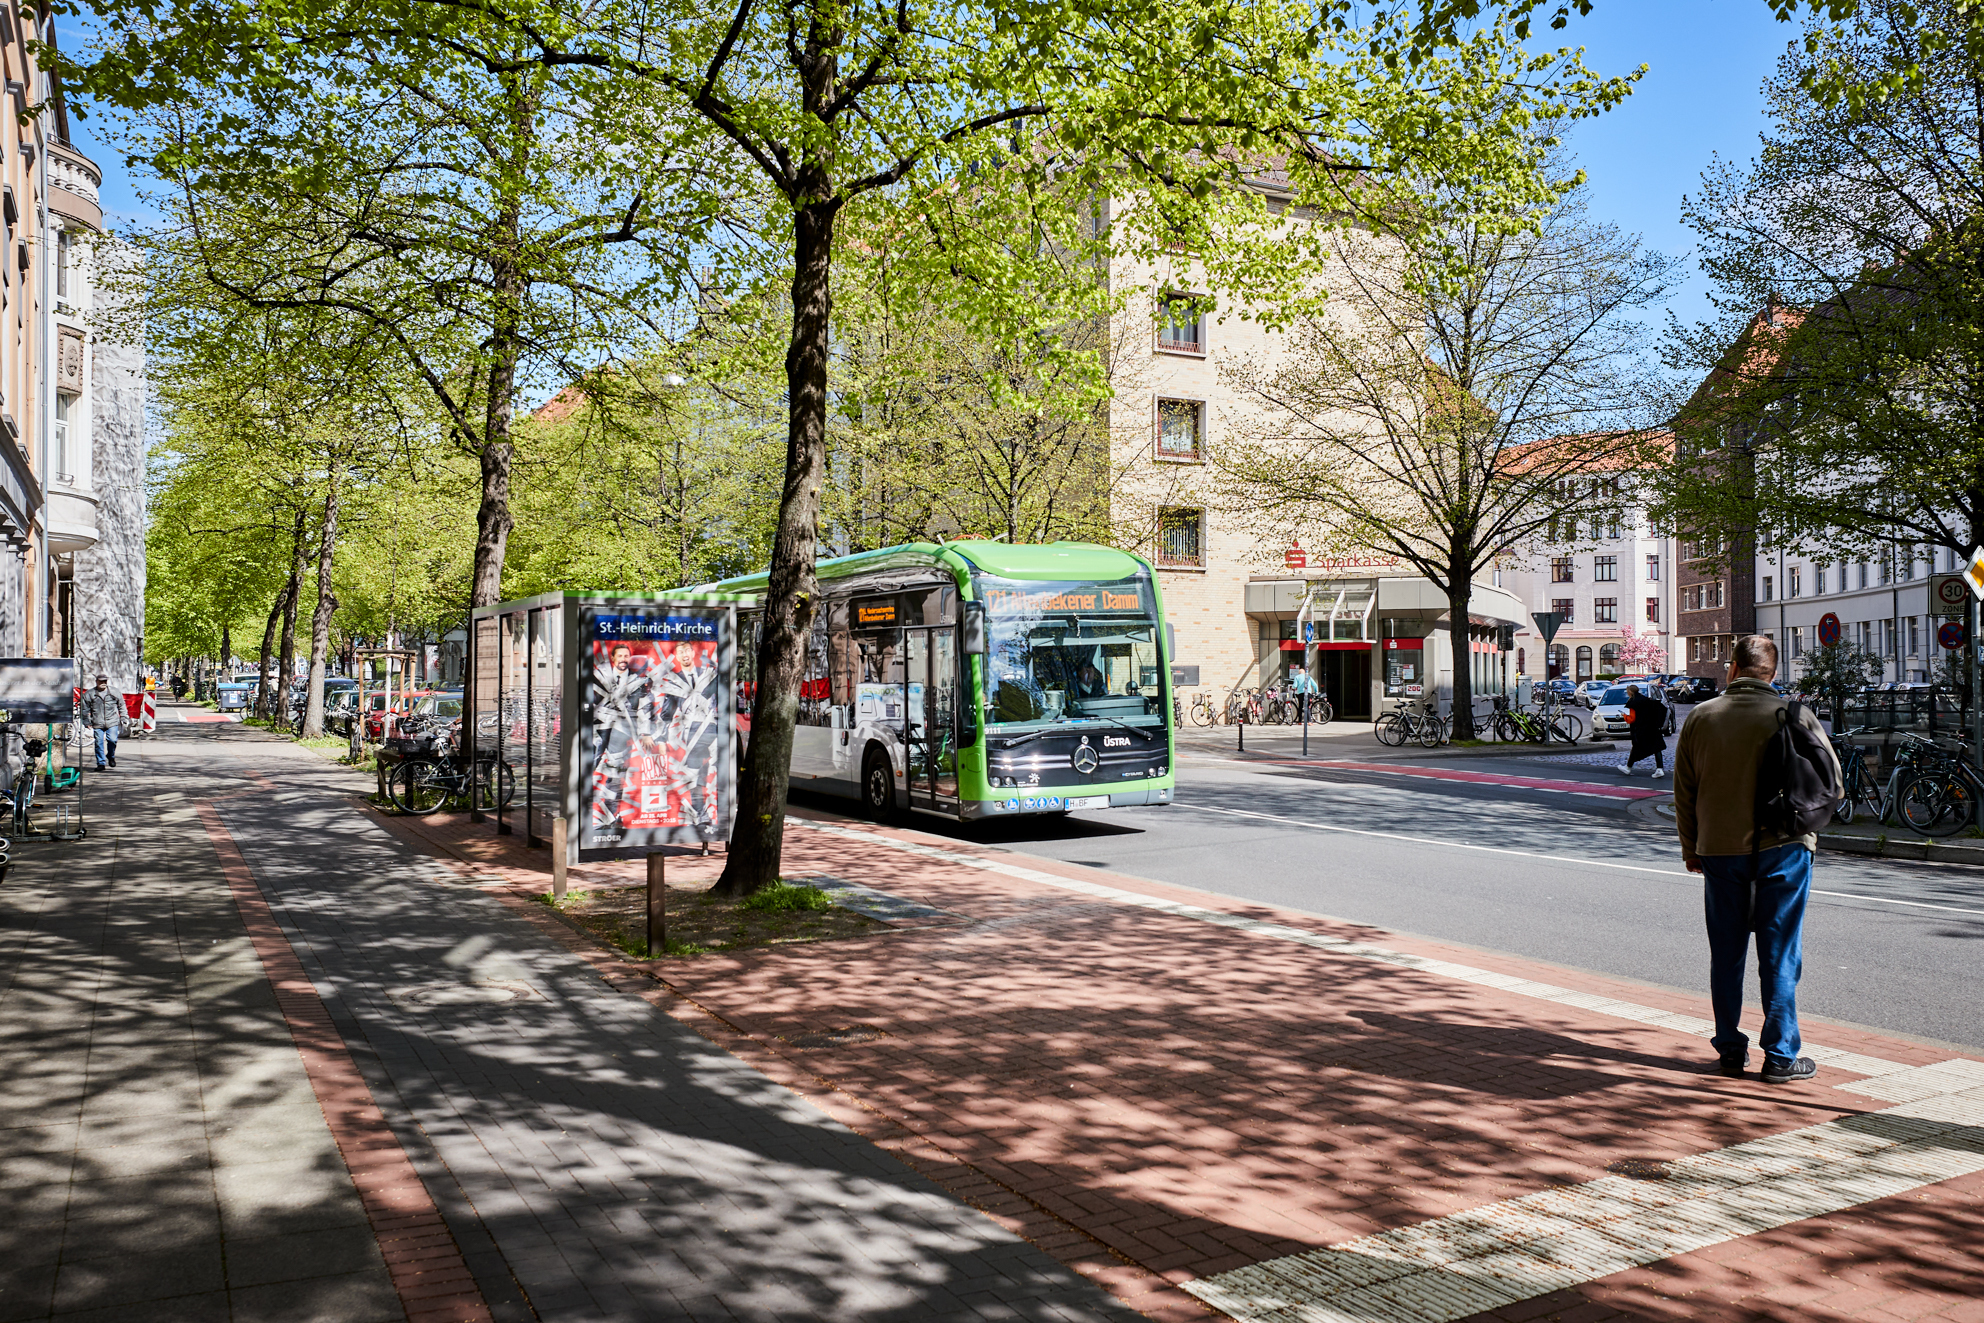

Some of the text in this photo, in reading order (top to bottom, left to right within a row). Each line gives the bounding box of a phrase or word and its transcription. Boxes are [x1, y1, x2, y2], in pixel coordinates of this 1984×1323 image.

[1316, 553, 1399, 571] Sparkasse
[1945, 585, 1962, 597] 30
[985, 590, 1139, 611] 121 Altenbekener Damm
[599, 621, 712, 635] St.-Heinrich-Kirche
[984, 726, 1001, 735] 9111
[1103, 735, 1131, 747] ÜSTRA
[592, 834, 622, 843] STRÖER
